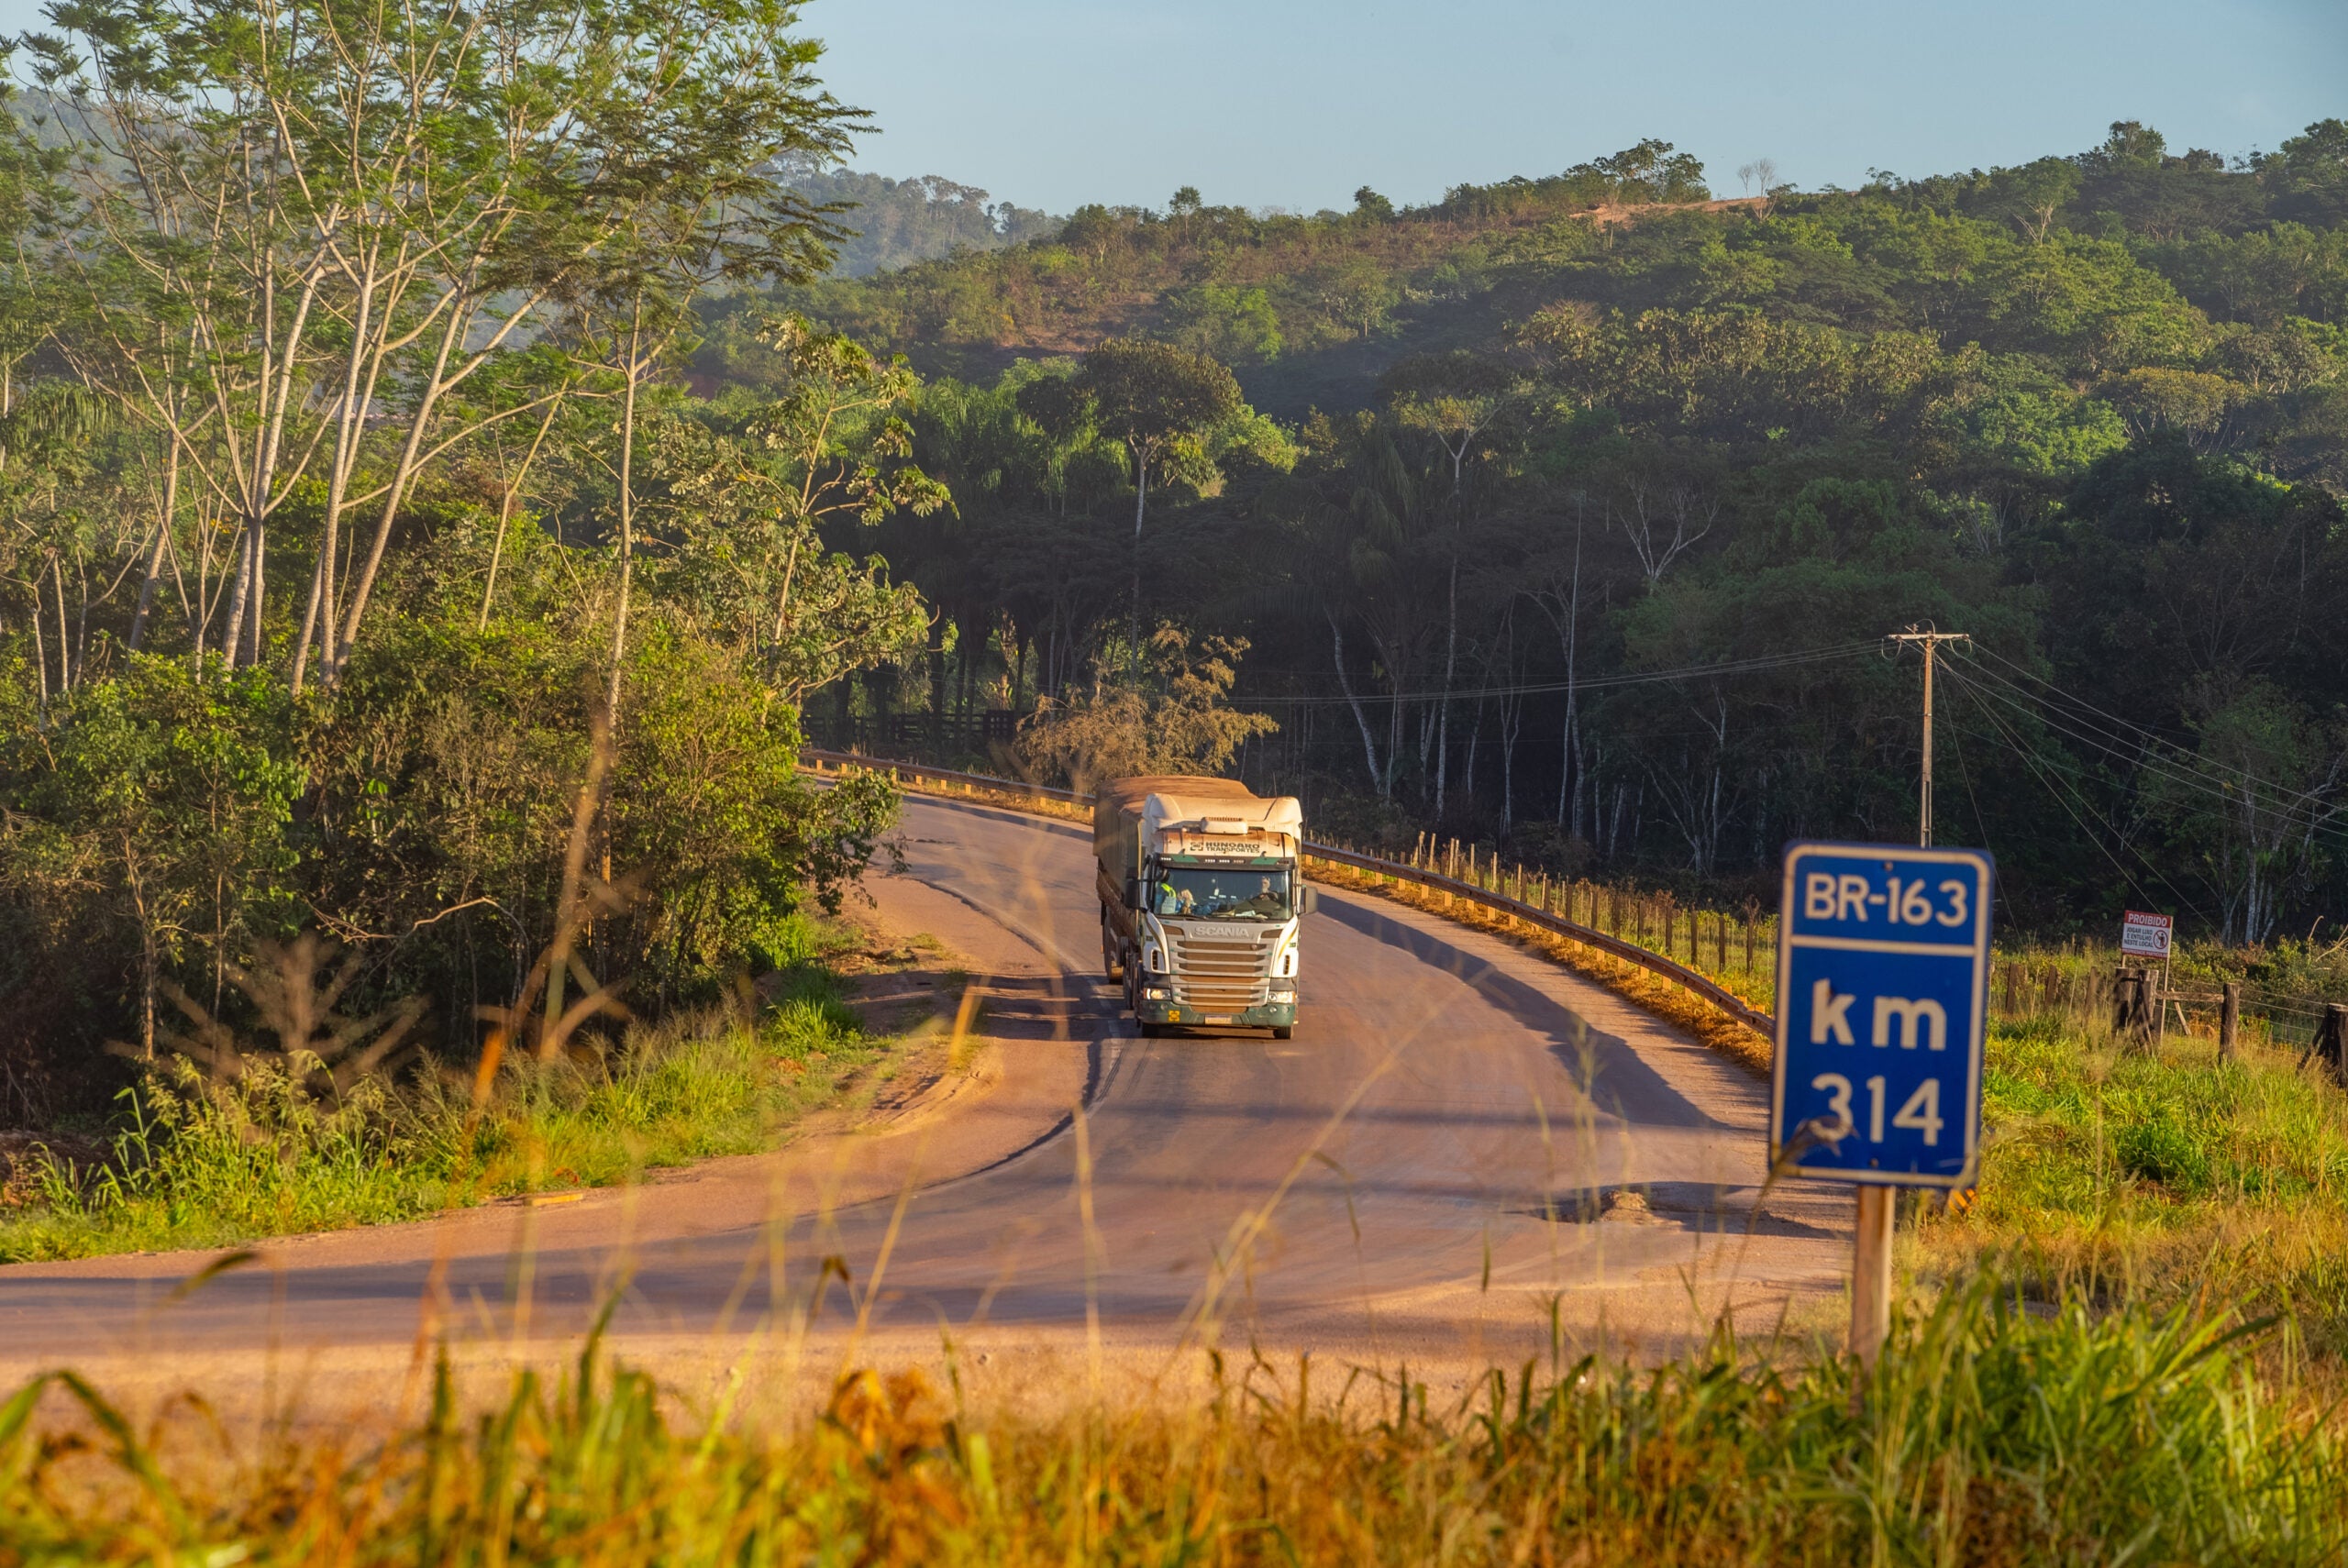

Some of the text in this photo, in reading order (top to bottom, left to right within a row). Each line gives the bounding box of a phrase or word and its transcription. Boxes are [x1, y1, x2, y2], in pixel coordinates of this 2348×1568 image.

[1804, 872, 1968, 928] BR-163
[2128, 913, 2167, 927] PROIBIDO
[1194, 926, 1249, 938] SCANIA
[1811, 977, 1947, 1051] km
[1811, 1073, 1944, 1146] 314
